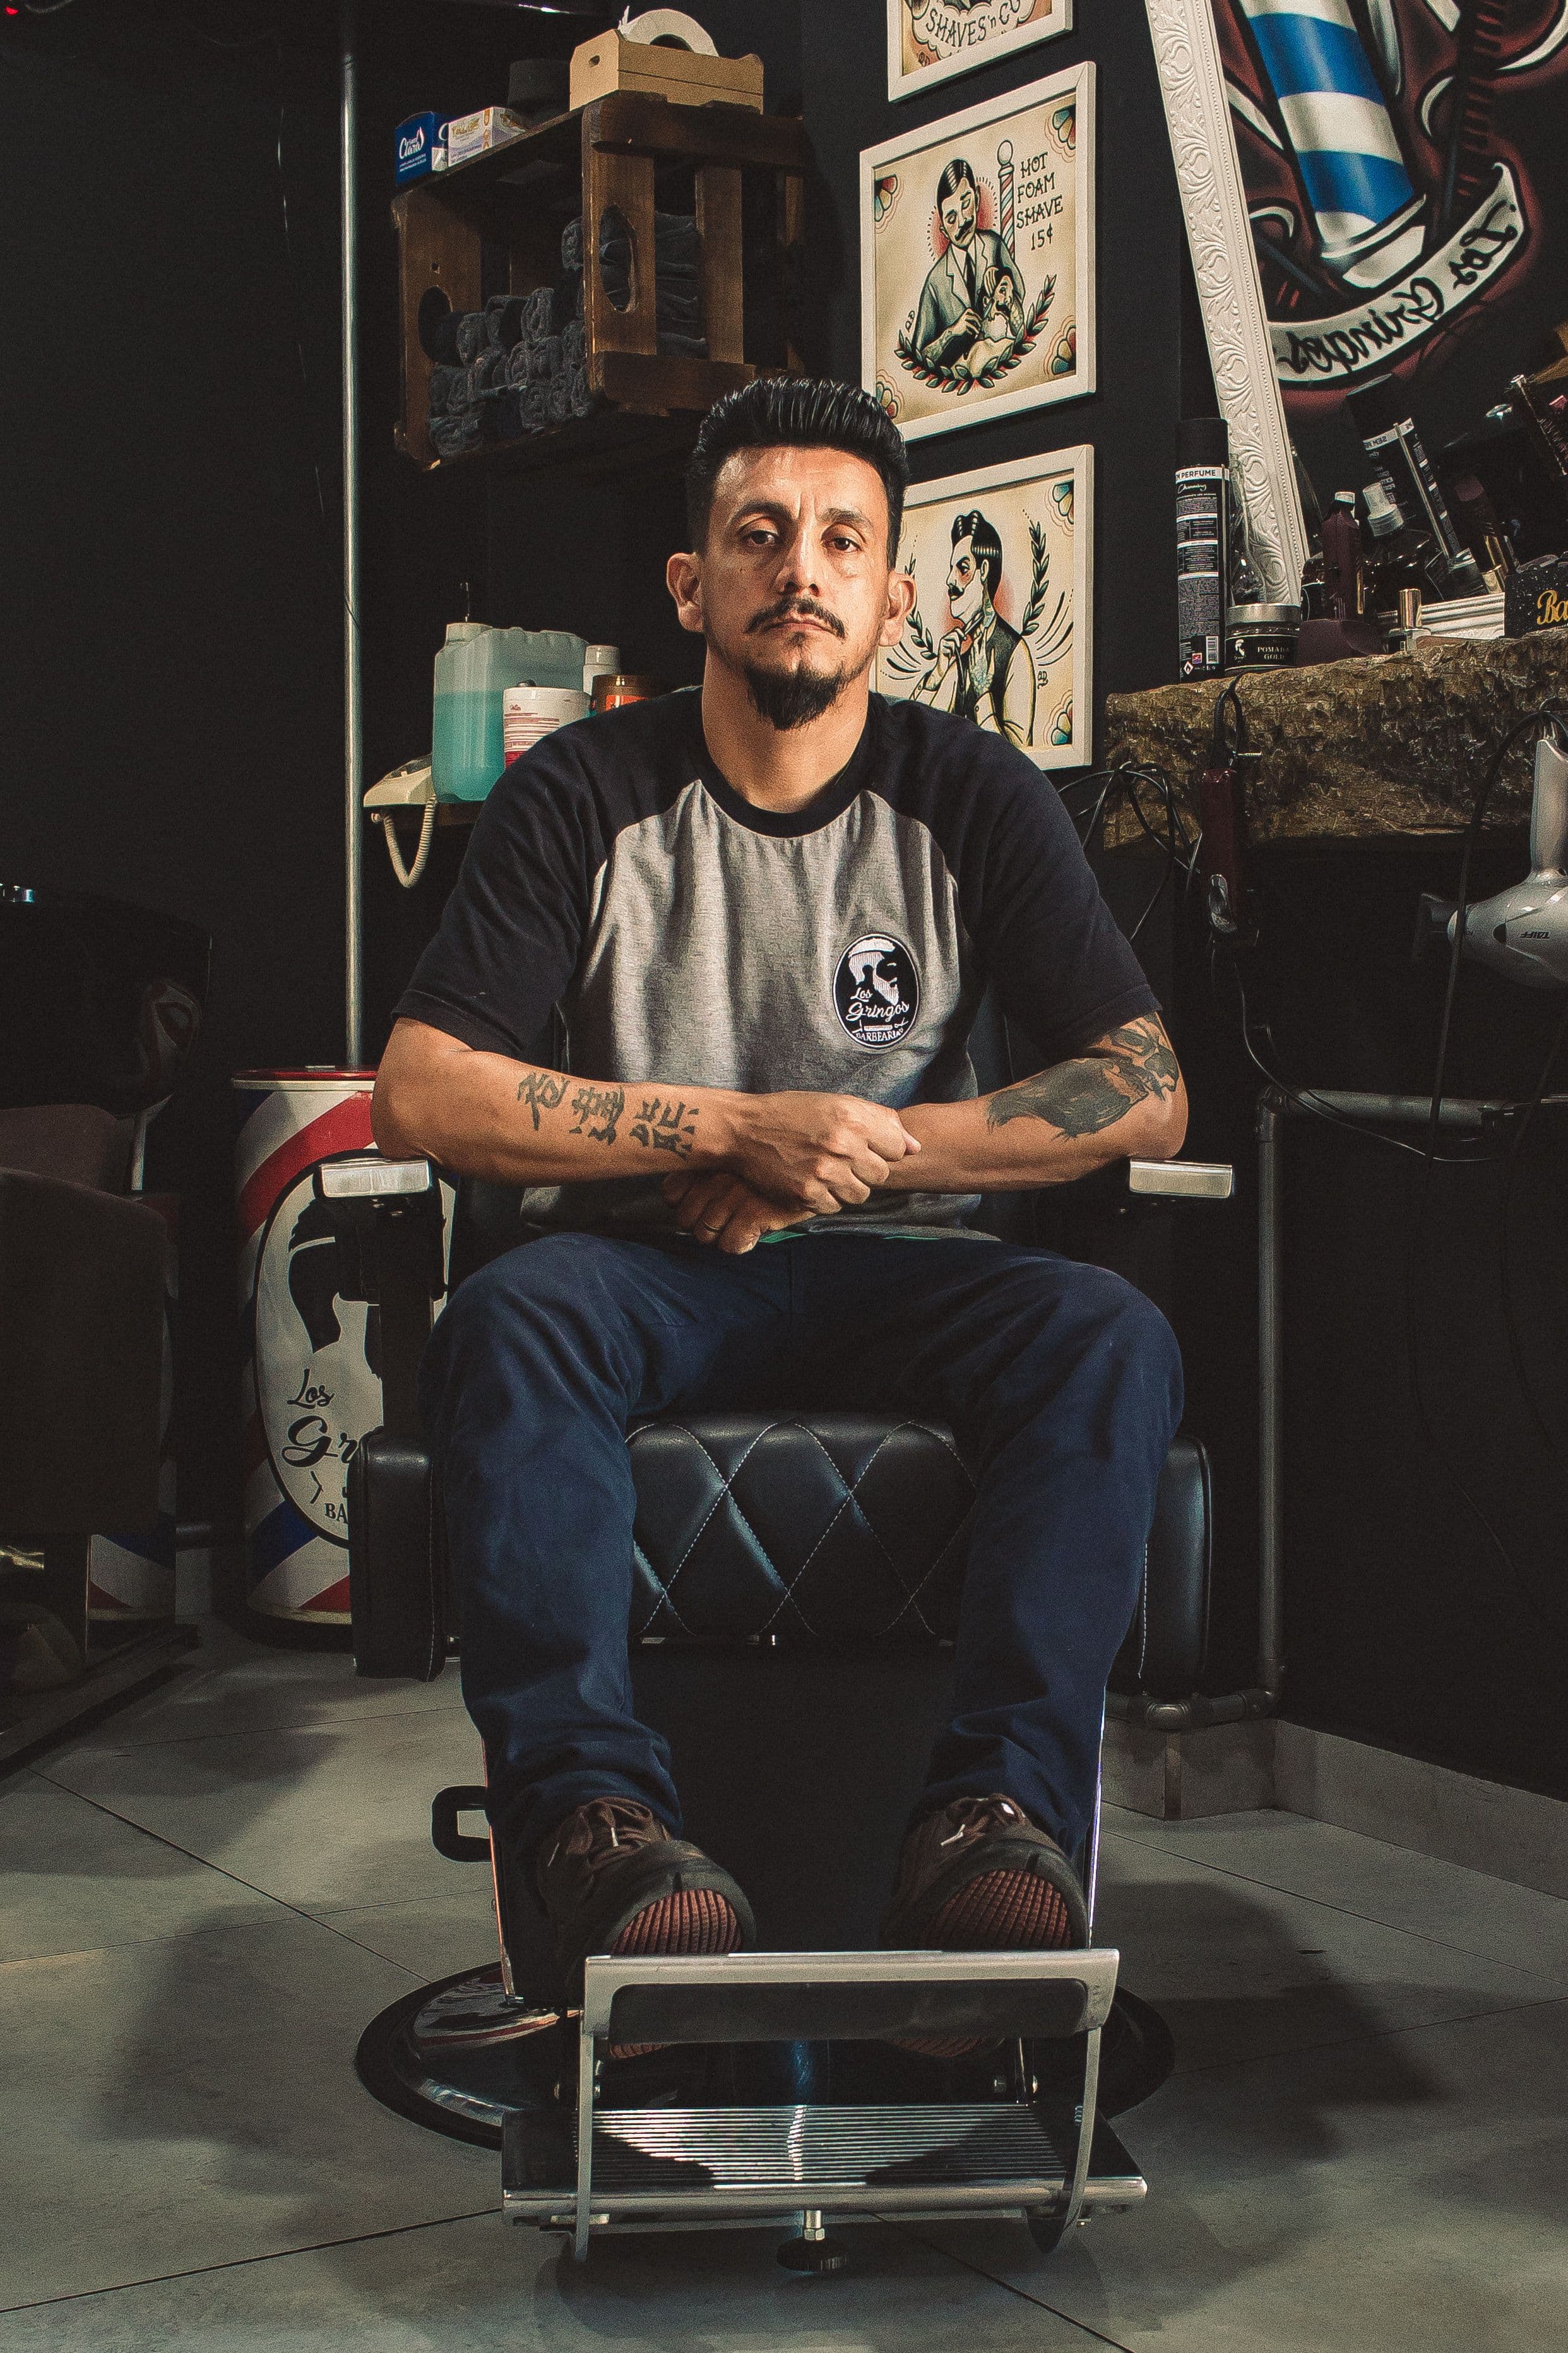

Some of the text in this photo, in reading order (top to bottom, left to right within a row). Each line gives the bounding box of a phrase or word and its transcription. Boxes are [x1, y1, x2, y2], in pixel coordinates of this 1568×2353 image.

[925, 8, 987, 47] SHAVES
[1020, 151, 1048, 179] HOT
[1017, 171, 1055, 204] FOAM
[1016, 194, 1064, 229] SHAVE
[1031, 222, 1053, 251] 15¢
[1181, 469, 1216, 478] PERFUME
[1519, 931, 1550, 939] TAIFF
[850, 987, 873, 1003] Los
[845, 1001, 910, 1023] Gringos
[287, 1368, 335, 1410] Los
[282, 1415, 359, 1468] Gr
[324, 1503, 349, 1525] BA
